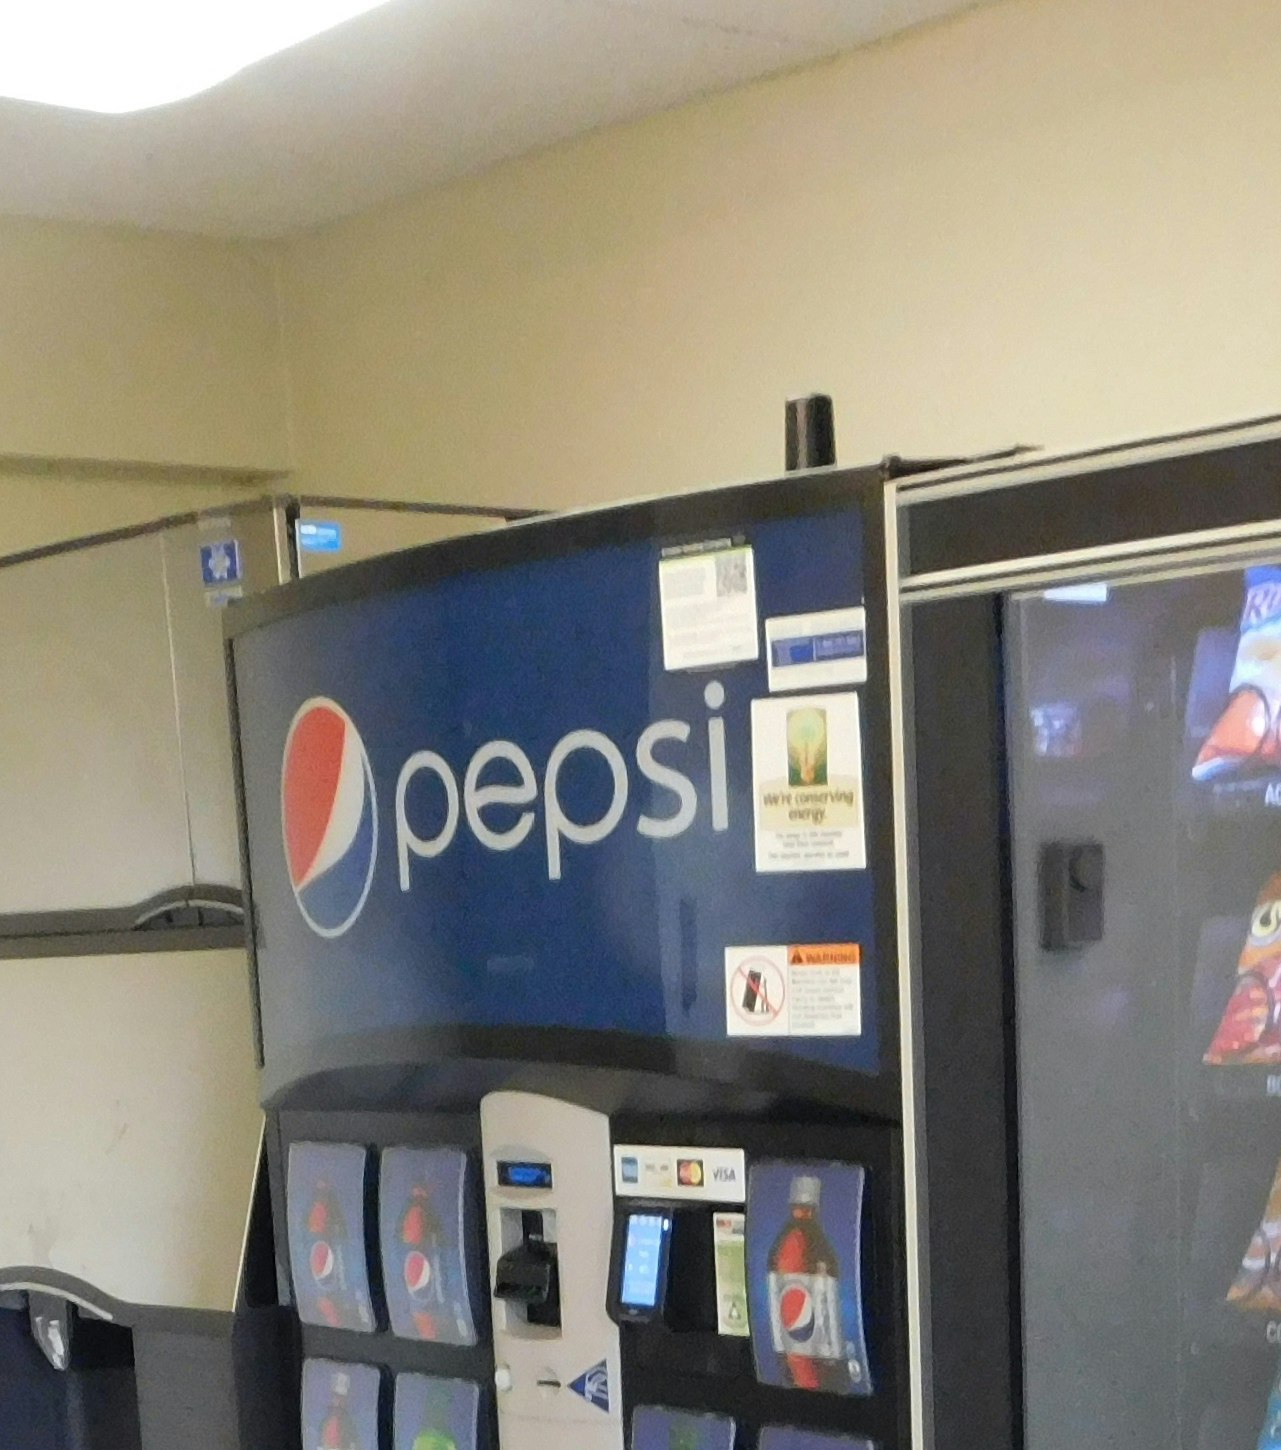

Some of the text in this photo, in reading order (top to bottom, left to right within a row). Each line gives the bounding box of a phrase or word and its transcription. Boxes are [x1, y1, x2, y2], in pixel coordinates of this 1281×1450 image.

[396, 680, 729, 892] pepsi
[795, 787, 854, 808] conserving
[806, 952, 857, 964] WARNING
[713, 1167, 737, 1183] VISA
